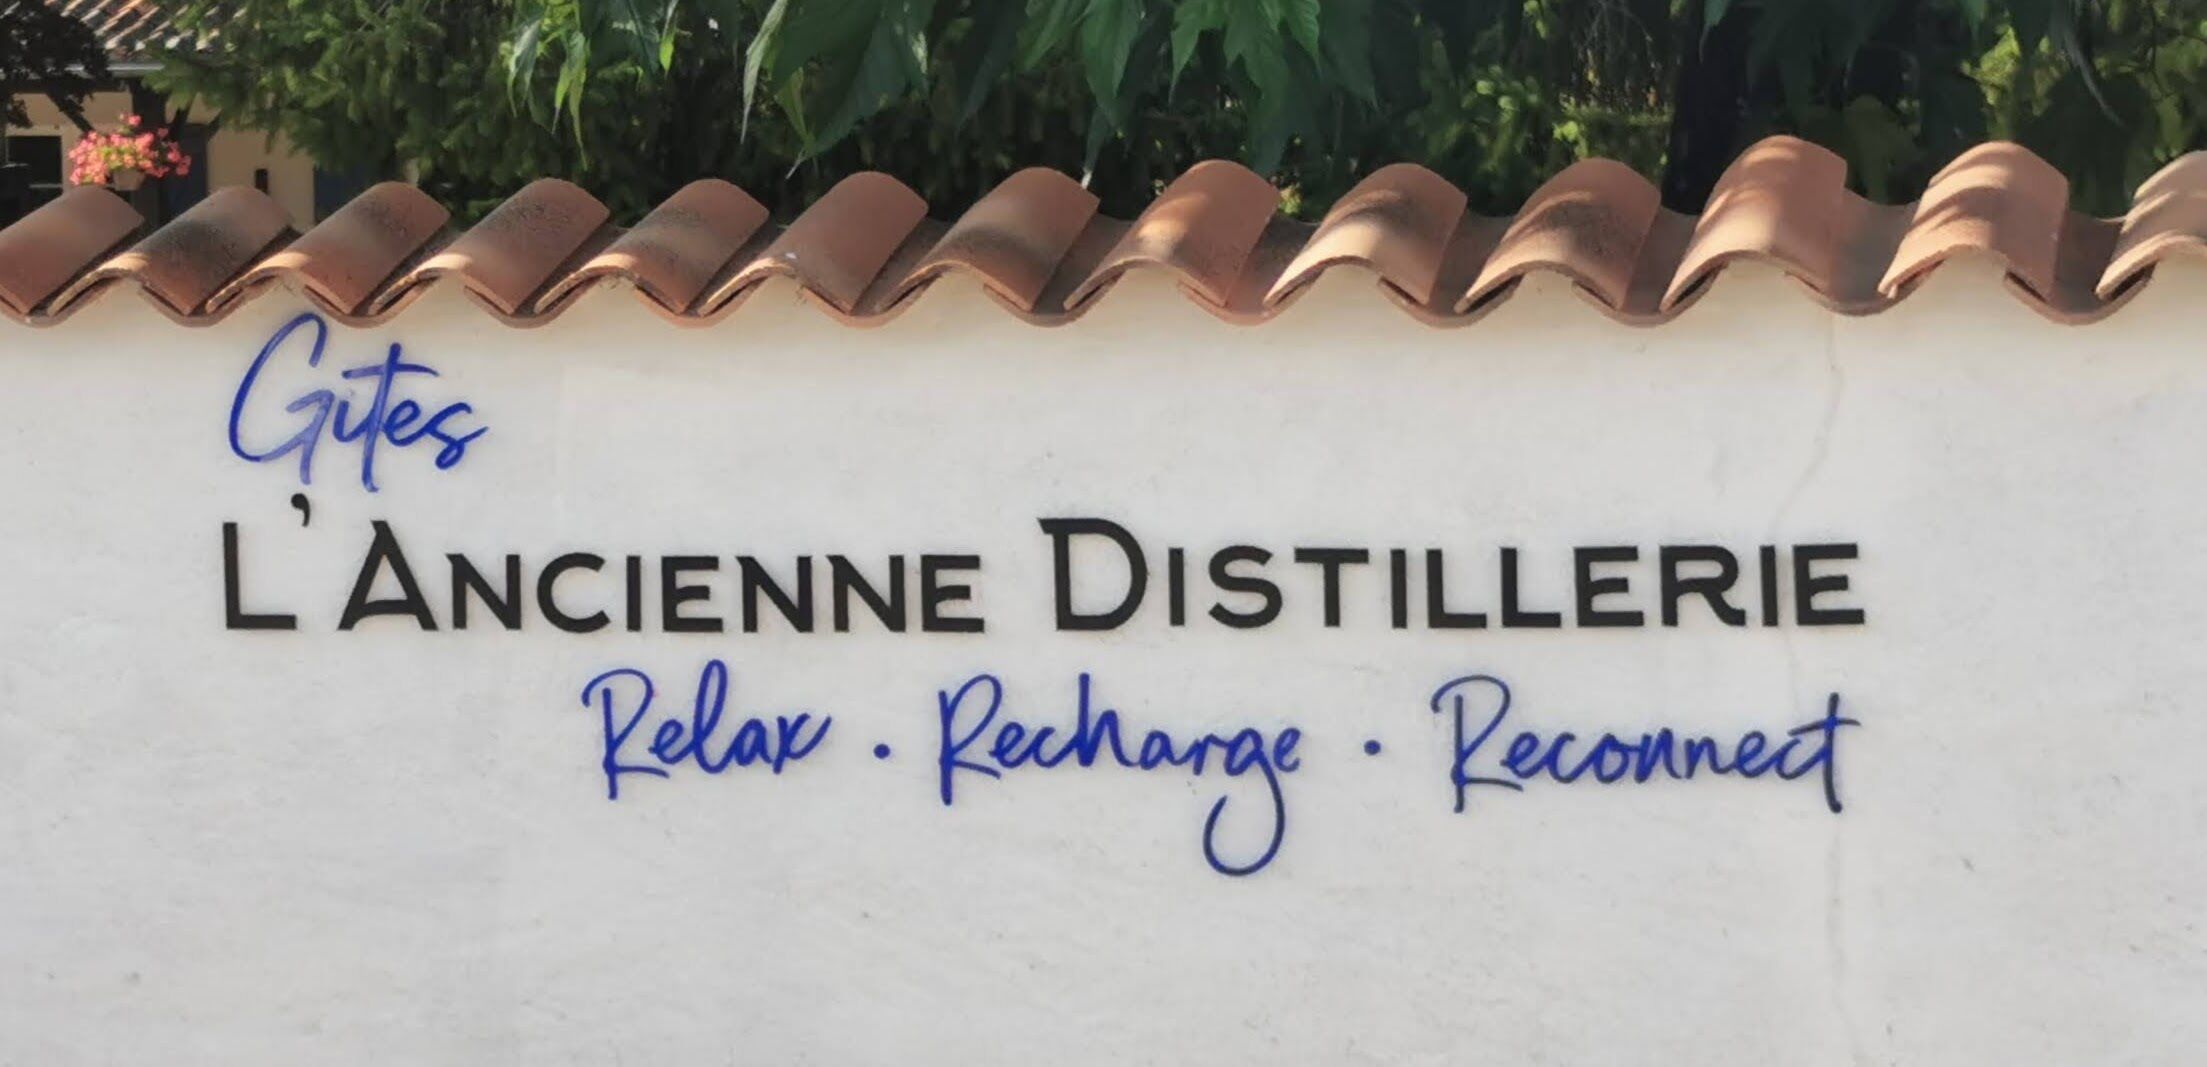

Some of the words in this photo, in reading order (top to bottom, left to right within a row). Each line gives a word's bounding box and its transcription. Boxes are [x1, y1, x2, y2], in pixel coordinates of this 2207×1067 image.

[1038, 517, 1866, 632] DISTILLERIE
[581, 660, 832, 801] Relax
[938, 673, 1302, 876] Recharge
[1431, 674, 1862, 813] Reconnect
